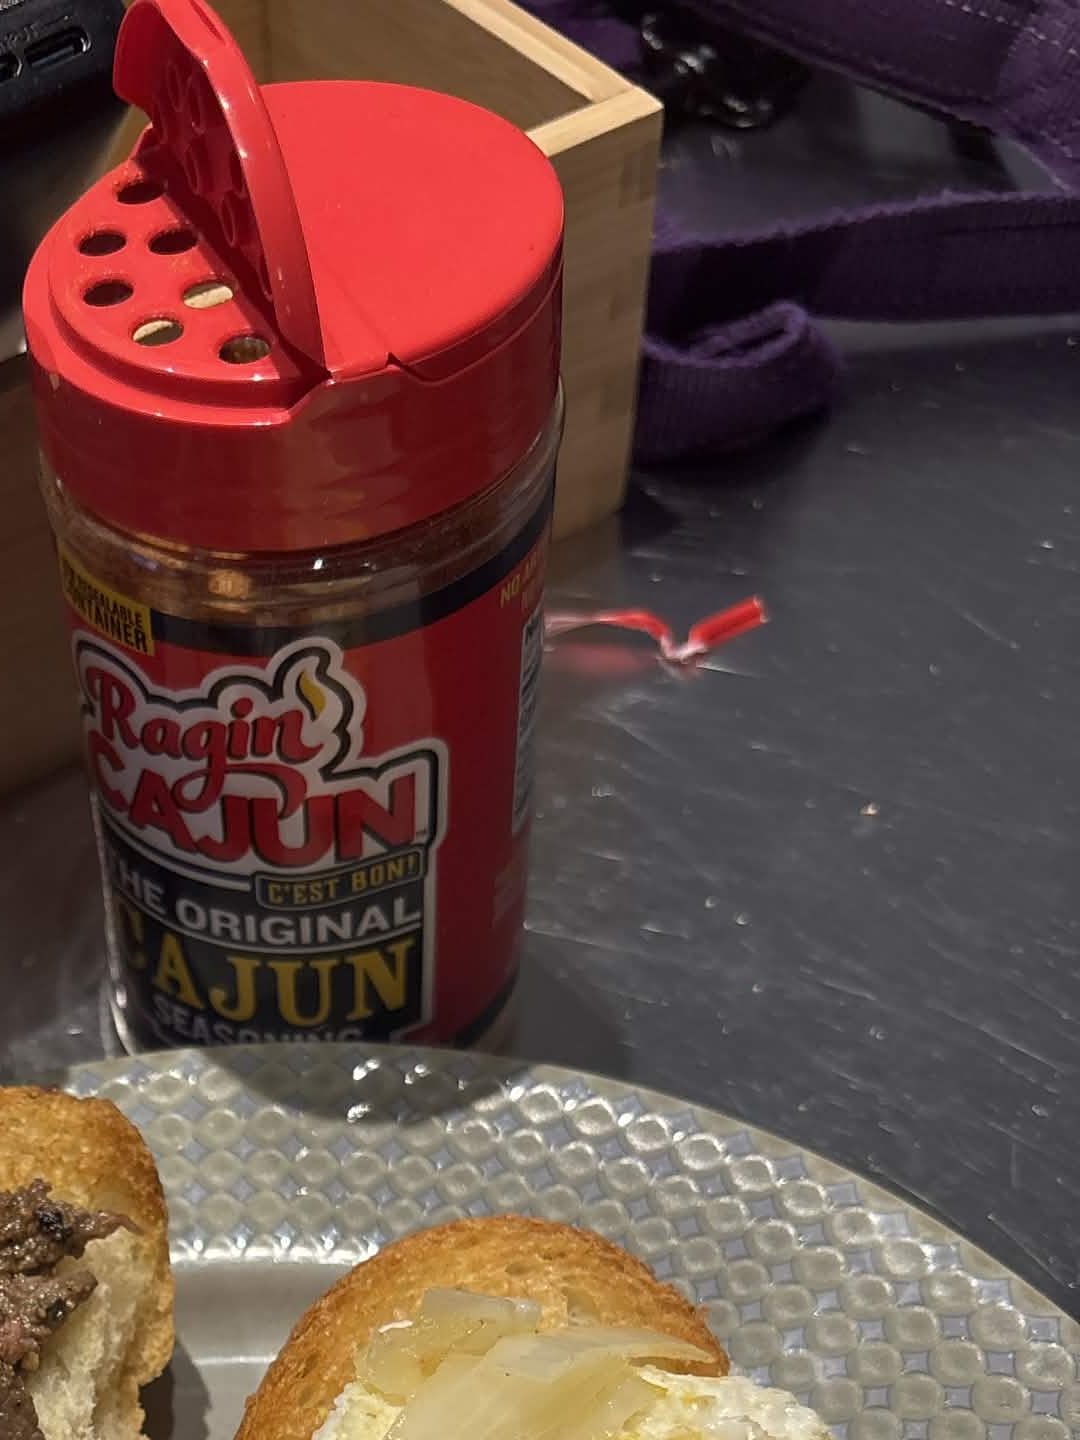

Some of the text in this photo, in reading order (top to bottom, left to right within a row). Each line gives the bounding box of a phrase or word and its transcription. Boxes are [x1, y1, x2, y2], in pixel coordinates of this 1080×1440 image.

[88, 730, 416, 865] CAJUN
[268, 852, 417, 905] C'EST BON!
[175, 897, 420, 945] ORIGINAL
